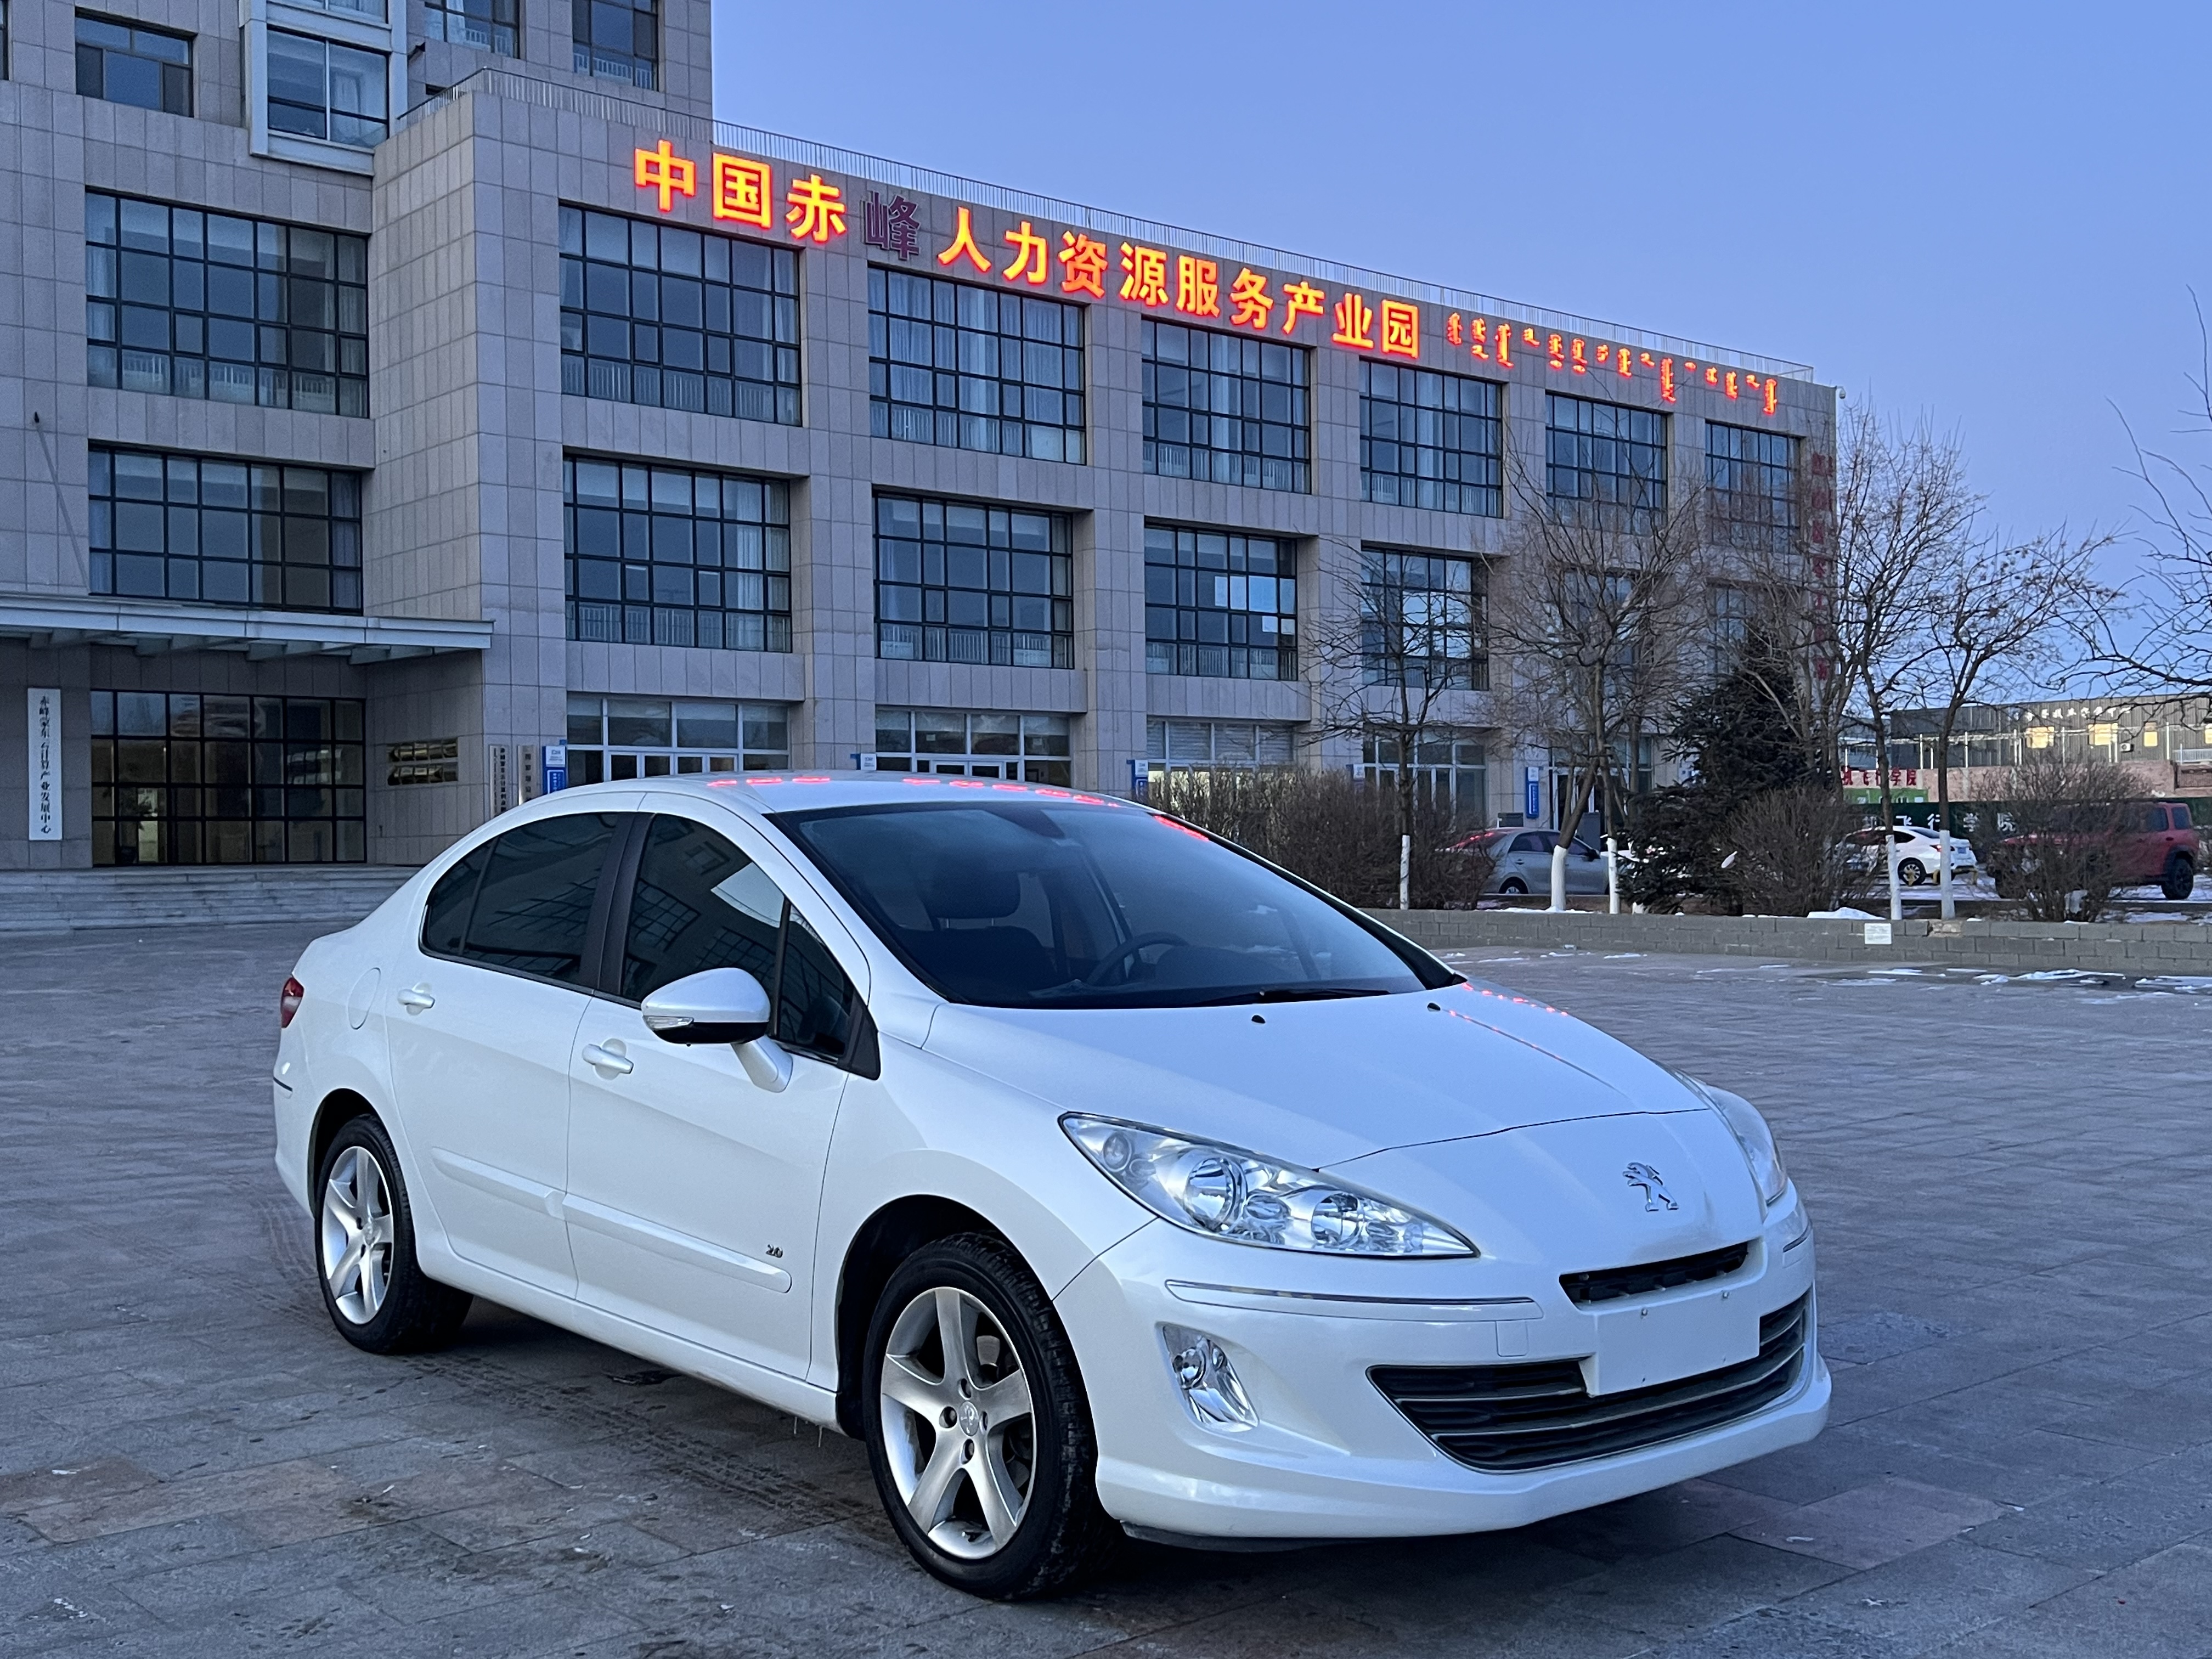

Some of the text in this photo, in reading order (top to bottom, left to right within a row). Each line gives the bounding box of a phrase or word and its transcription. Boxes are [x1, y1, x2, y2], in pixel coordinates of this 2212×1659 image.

[634, 139, 1420, 359] 中国赤峰人力资源服务产业园
